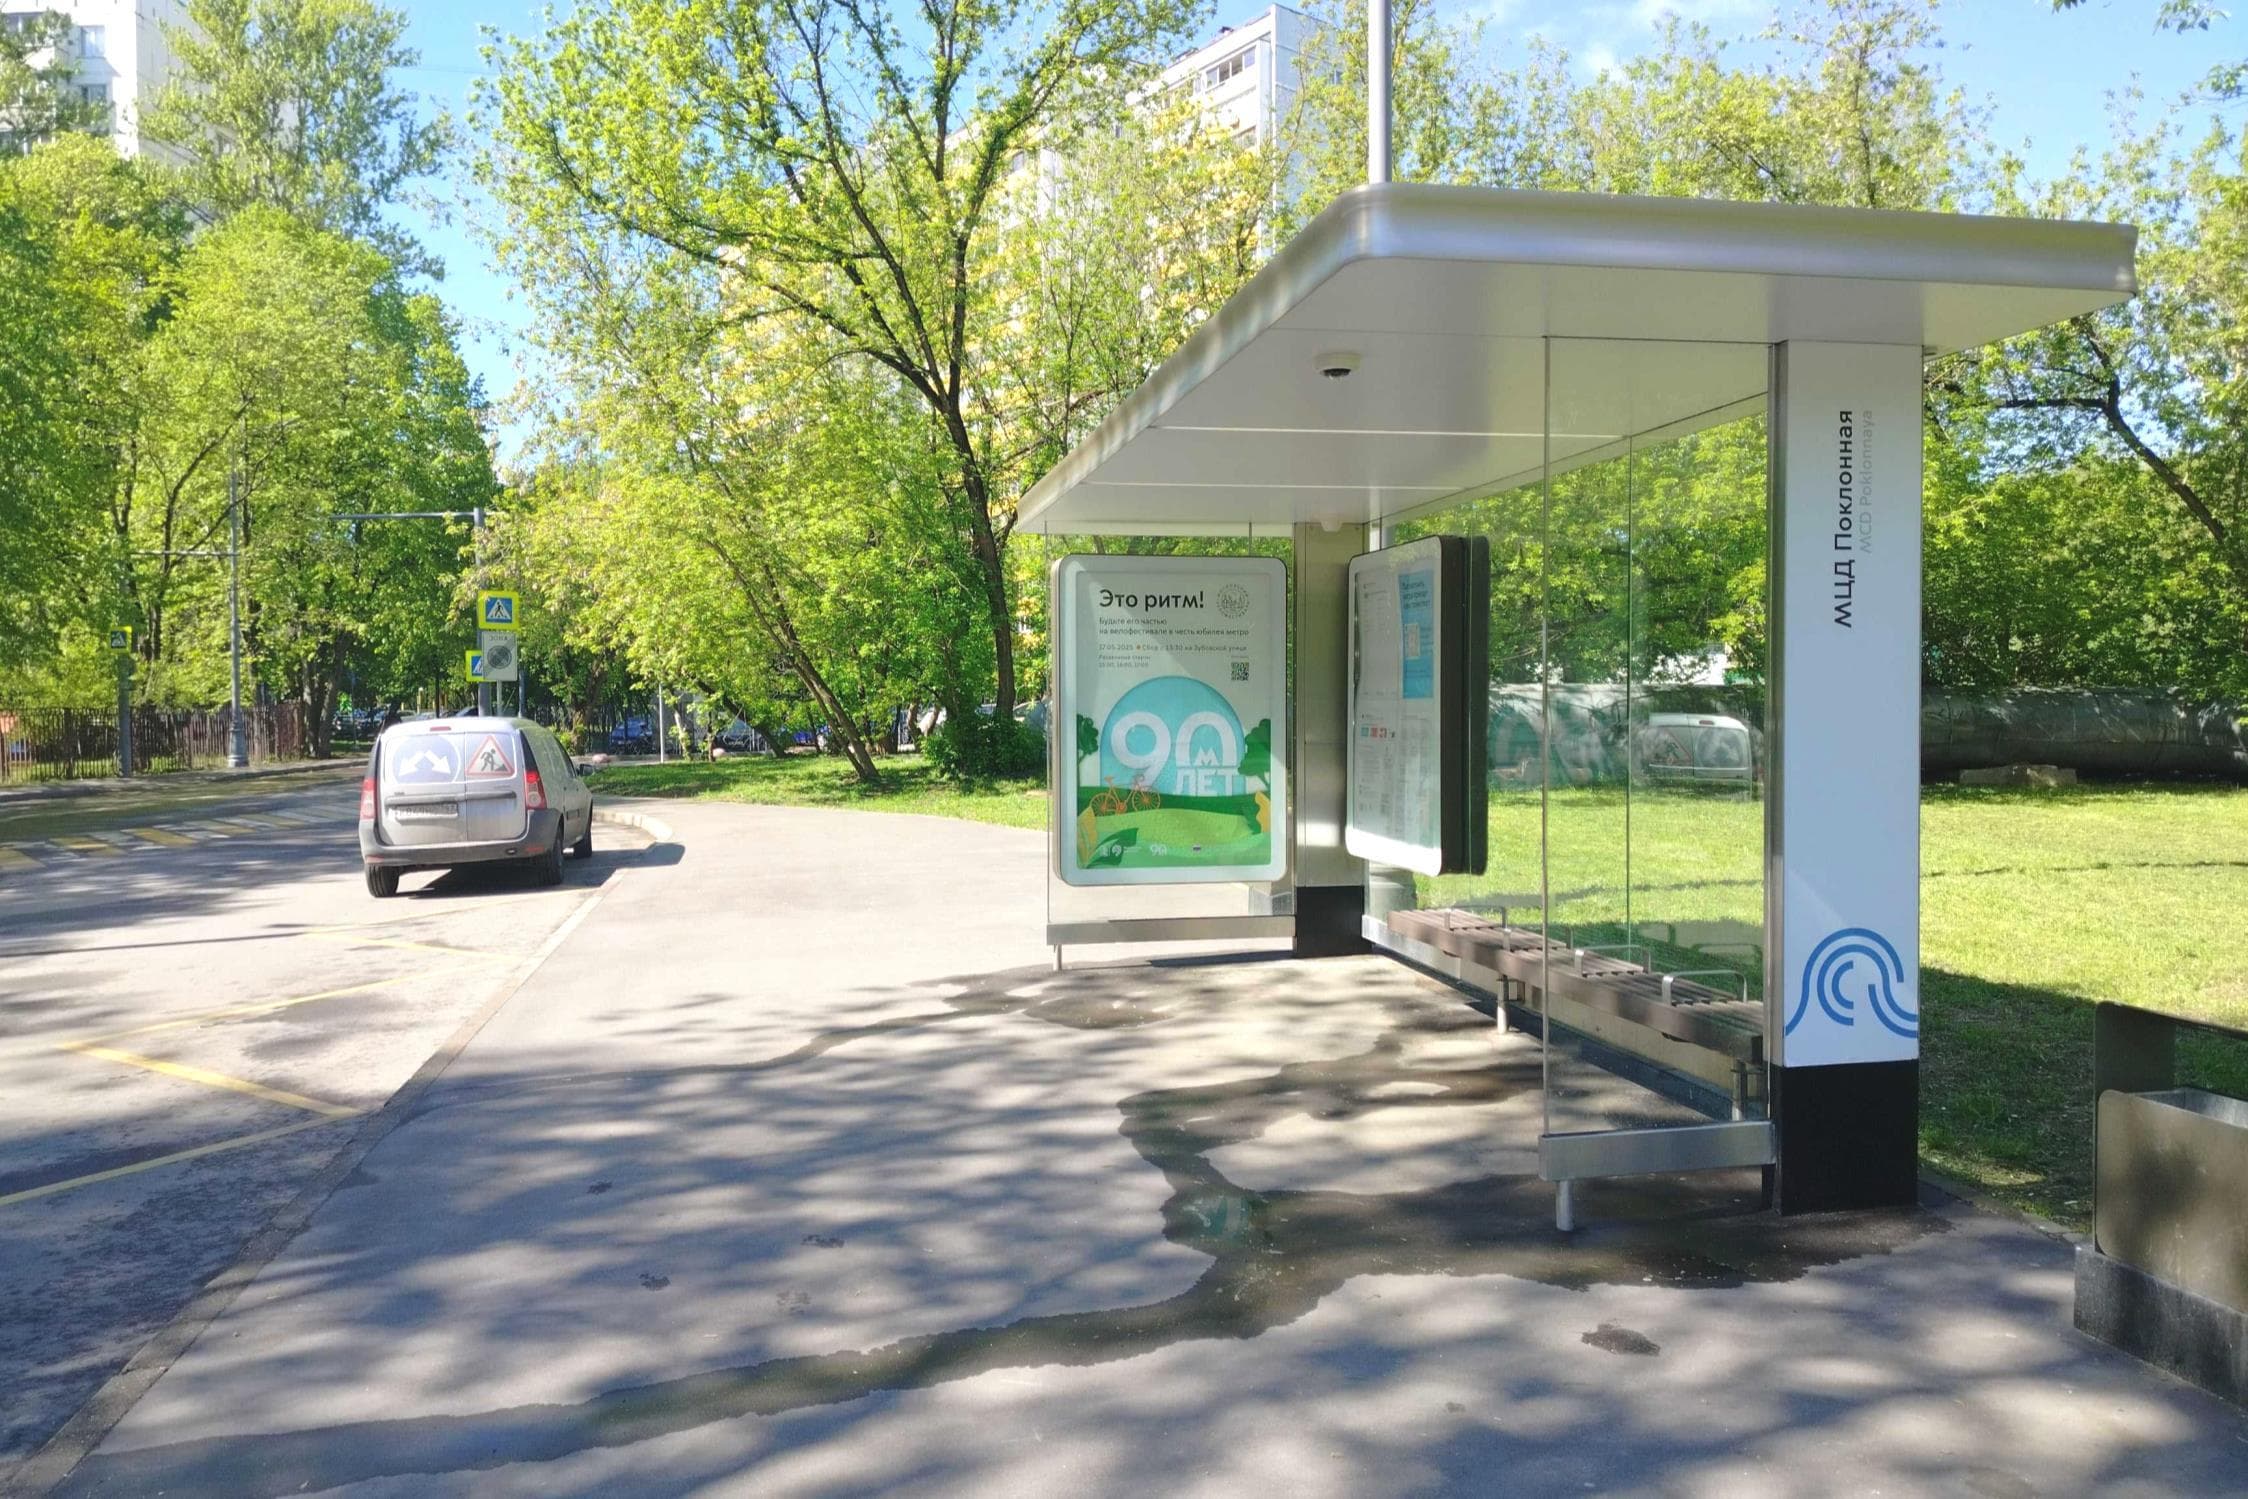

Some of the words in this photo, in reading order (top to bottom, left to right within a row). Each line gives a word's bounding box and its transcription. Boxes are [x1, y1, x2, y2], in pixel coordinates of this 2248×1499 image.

[1859, 410, 1875, 508] Poklonnaya
[1834, 411, 1853, 551] Поклонная
[1859, 513, 1872, 554] MCD
[1099, 589, 1138, 608] Это
[1145, 591, 1204, 612] ритм!
[1834, 559, 1856, 628] МЦД
[1226, 628, 1249, 637] метро
[1172, 768, 1237, 797] ЛЕТ
